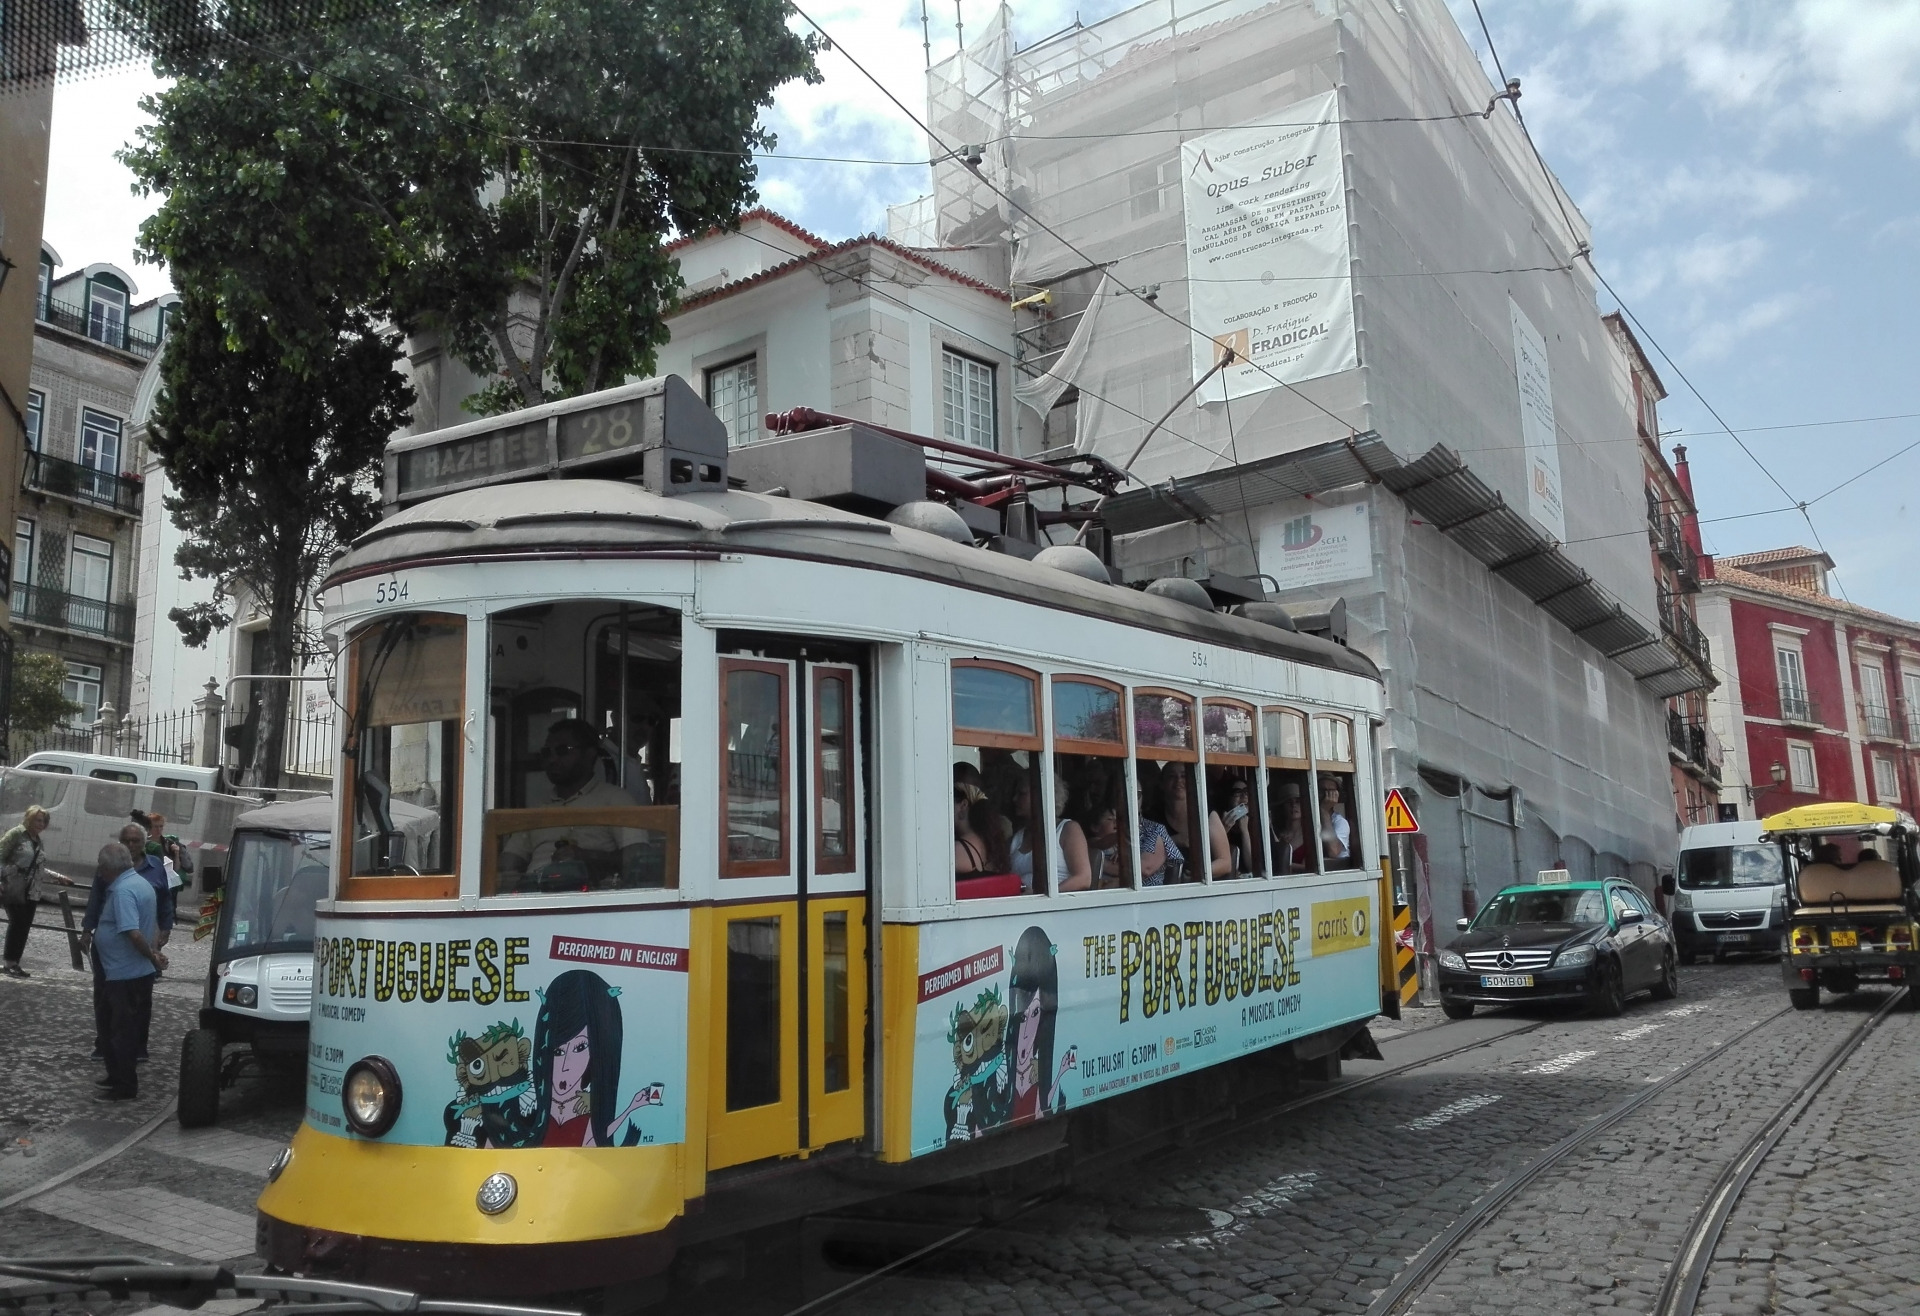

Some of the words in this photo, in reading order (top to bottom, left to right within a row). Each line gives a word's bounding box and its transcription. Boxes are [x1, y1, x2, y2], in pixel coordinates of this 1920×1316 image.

[1278, 125, 1315, 142] Integrada
[1207, 176, 1249, 198] Opus
[1261, 154, 1317, 182] Suber
[1201, 214, 1248, 234] ARGAMASSAS
[1251, 210, 1262, 218] DE
[1266, 191, 1327, 214] REVESTIMENTO
[1215, 203, 1234, 215] lime
[1238, 195, 1260, 207] cork
[1263, 181, 1311, 201] rendering
[1192, 235, 1238, 255] GRANULADOS
[1242, 230, 1252, 239] DE
[1256, 219, 1290, 235] CORTIÇA
[1294, 204, 1341, 222] EXPANDIDA
[1204, 233, 1219, 242] CAL
[1250, 216, 1269, 227] CL90
[1274, 212, 1285, 220] EM
[1289, 203, 1315, 216] PASTA
[1252, 322, 1329, 355] FRADICAL
[1240, 353, 1305, 376] www.fradical.pt
[581, 405, 633, 455] 28
[376, 579, 409, 604] 554
[1192, 651, 1208, 667] 554
[1317, 910, 1348, 940] carris
[557, 941, 616, 960] PERFORMED
[620, 948, 633, 962] IN
[636, 949, 678, 966] ENGLISH
[1083, 934, 1116, 979] THE
[1119, 906, 1301, 1025] PORTUGUESE
[319, 936, 531, 1006] PORTUGUESE
[924, 967, 962, 996] PERFORMED
[964, 963, 971, 980] IN
[973, 952, 999, 975] ENGLISH
[341, 1006, 366, 1023] COMEDY
[1241, 1007, 1247, 1027] A
[1248, 1000, 1275, 1026] MUSICAL
[1277, 993, 1301, 1017] COMEDY
